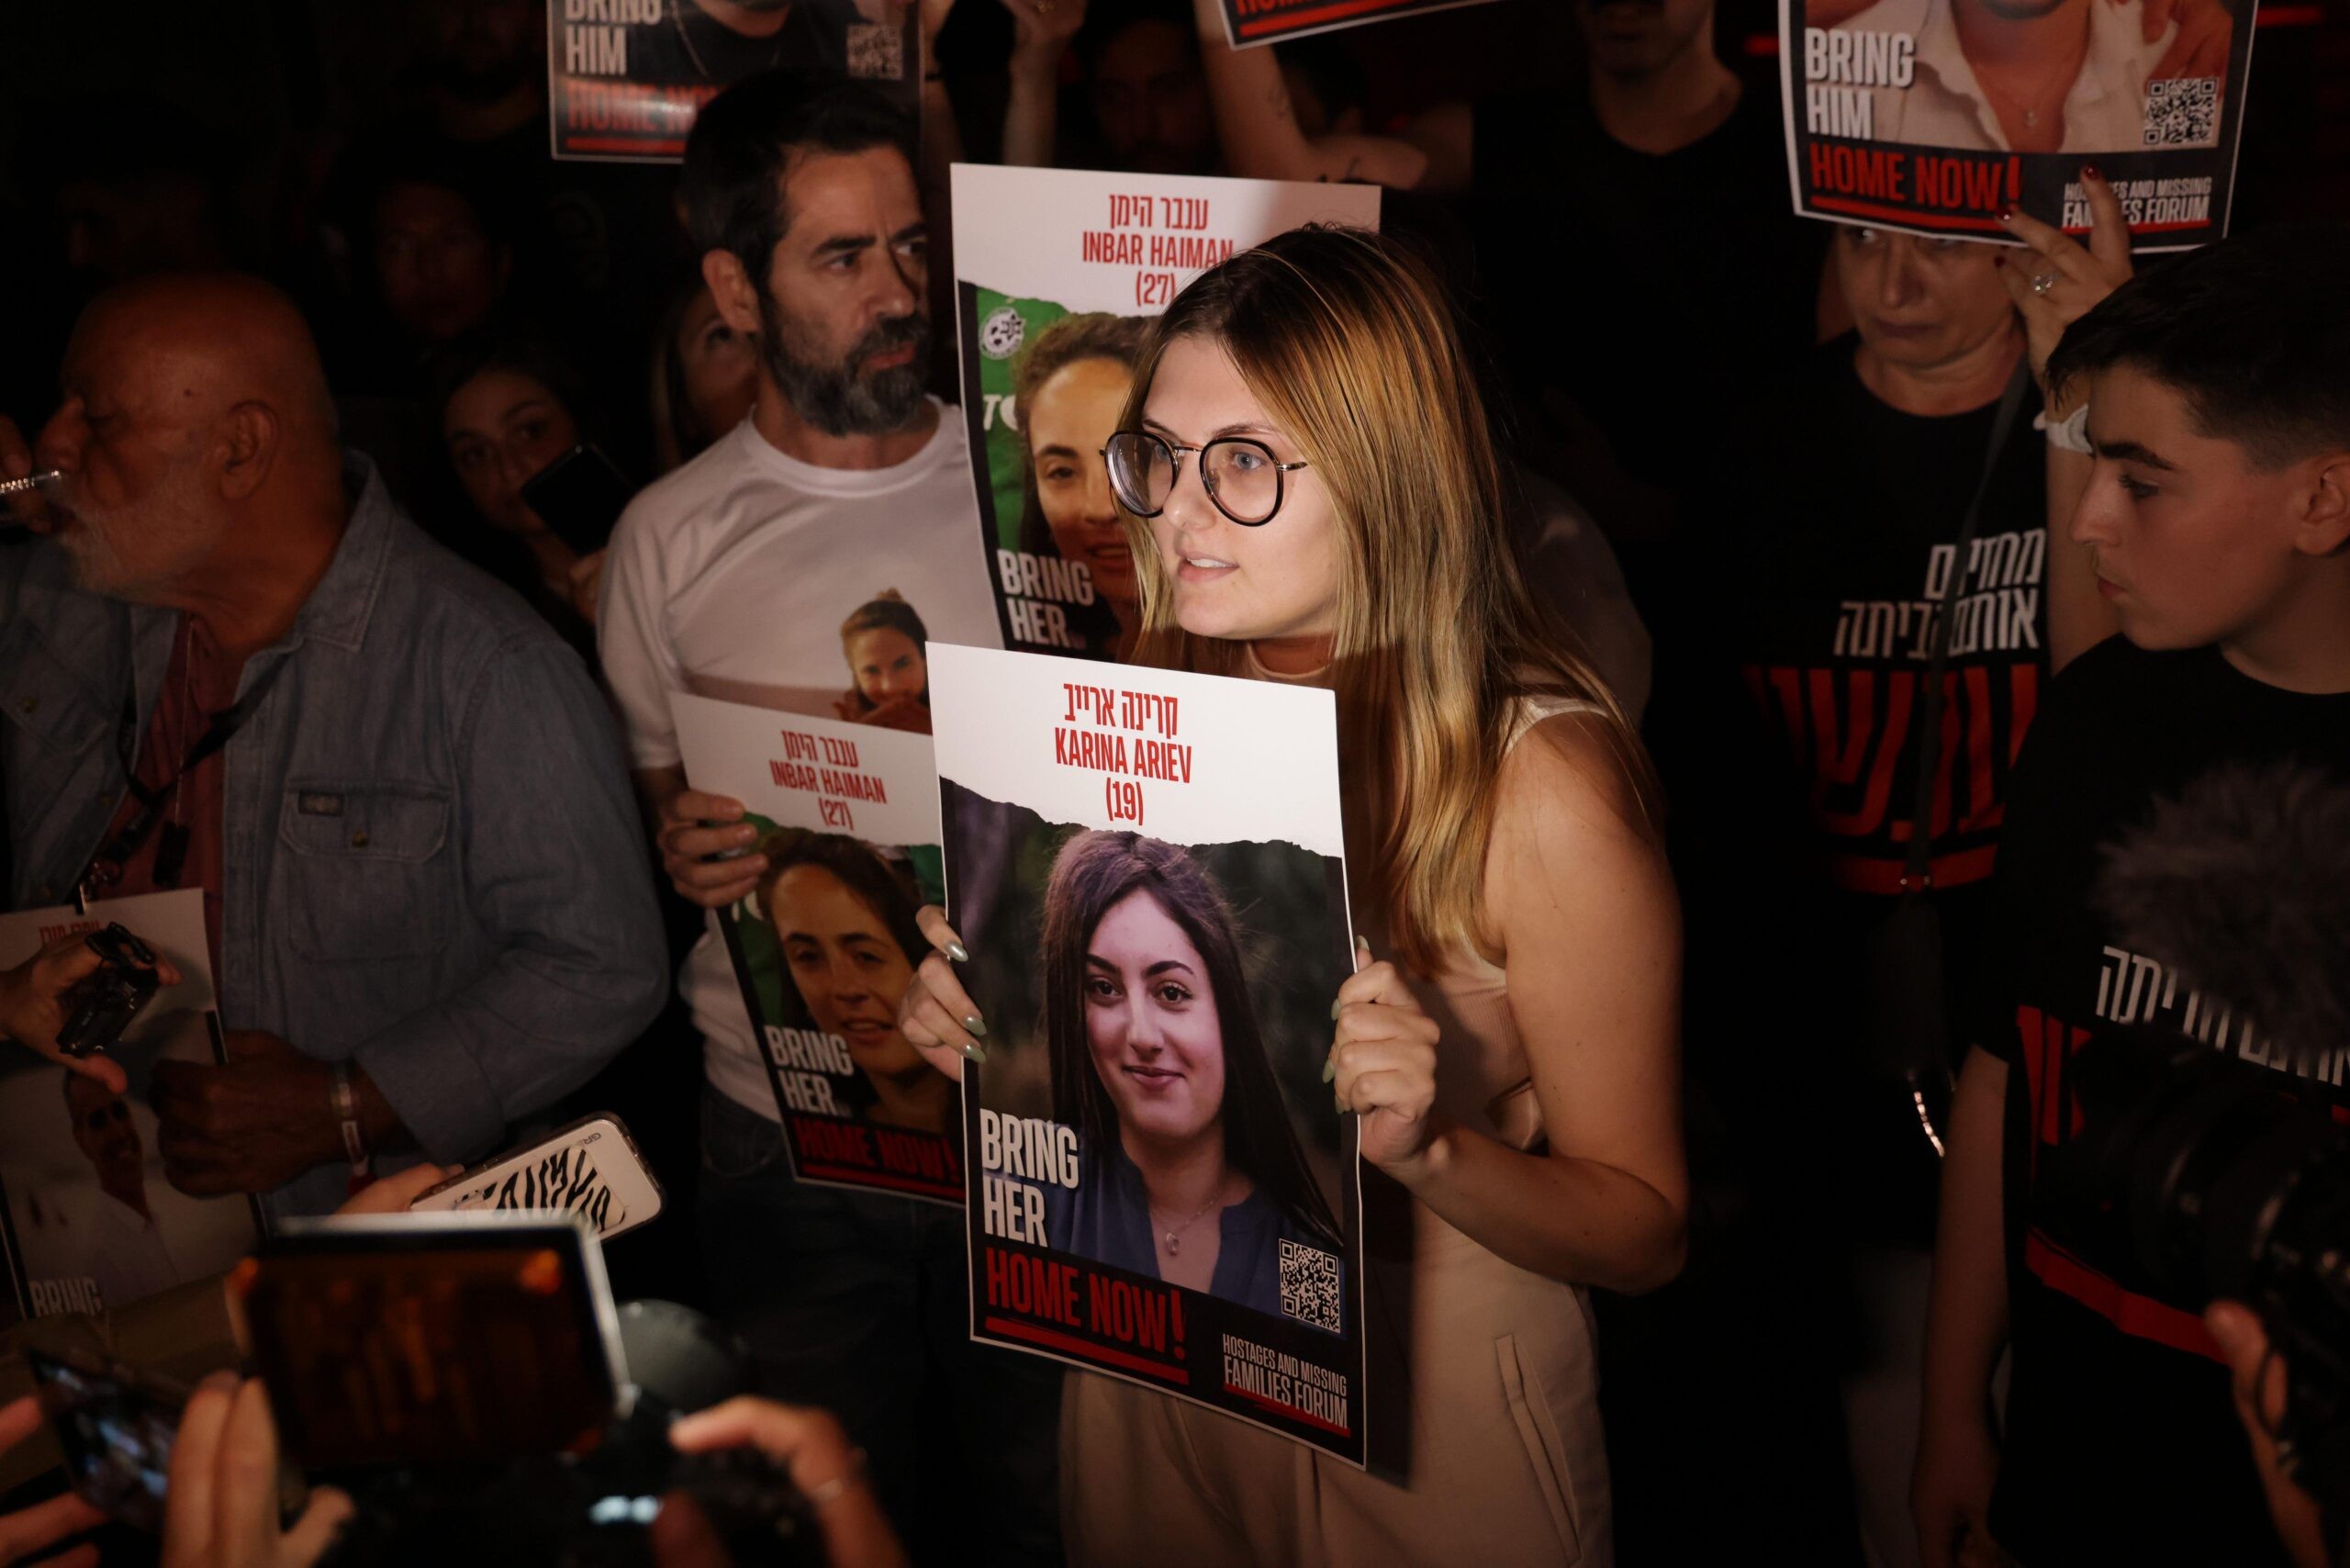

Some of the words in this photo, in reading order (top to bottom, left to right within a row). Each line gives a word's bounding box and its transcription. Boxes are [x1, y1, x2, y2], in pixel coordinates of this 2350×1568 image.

[566, 26, 627, 75] HIM
[1805, 28, 1916, 87] BRING
[1807, 84, 1873, 140] HIM
[1809, 142, 1906, 202] HOME
[1915, 155, 2023, 212] NOW!
[2129, 180, 2155, 198] AND
[2155, 176, 2212, 196] MISSING
[1109, 194, 1152, 228] הימן
[1160, 197, 1208, 230] ענבר
[2145, 196, 2210, 224] FORUM
[1082, 231, 1143, 265] INBAR
[1150, 237, 1233, 269] HAIMAN
[1136, 271, 1175, 307] (27)
[997, 548, 1094, 607] BRING
[1006, 597, 1071, 649] HER
[1063, 683, 1116, 727] ארייב
[1122, 690, 1178, 739] קרינה
[781, 730, 818, 762] הימן
[819, 735, 858, 767] ענבר
[1055, 727, 1128, 774] KARINA
[1134, 738, 1192, 783] ARIEV
[769, 759, 820, 792] INBAR
[821, 768, 887, 803] HAIMAN
[1105, 777, 1143, 826] (19)
[819, 797, 853, 830] (27)
[763, 1025, 855, 1077] BRING
[778, 1069, 839, 1117] HER
[792, 1115, 877, 1167] HOME
[875, 1128, 962, 1184] NOW!
[979, 1108, 1080, 1190] BRING
[982, 1173, 1049, 1248] HER
[985, 1247, 1082, 1327] HOME
[1089, 1271, 1187, 1361] NOW!
[1223, 1333, 1276, 1370] HOSTAGES
[1278, 1352, 1298, 1377] AND
[1301, 1360, 1347, 1396] MISSING
[1224, 1354, 1292, 1406] FAMILIES
[1294, 1379, 1348, 1429] FORUM
